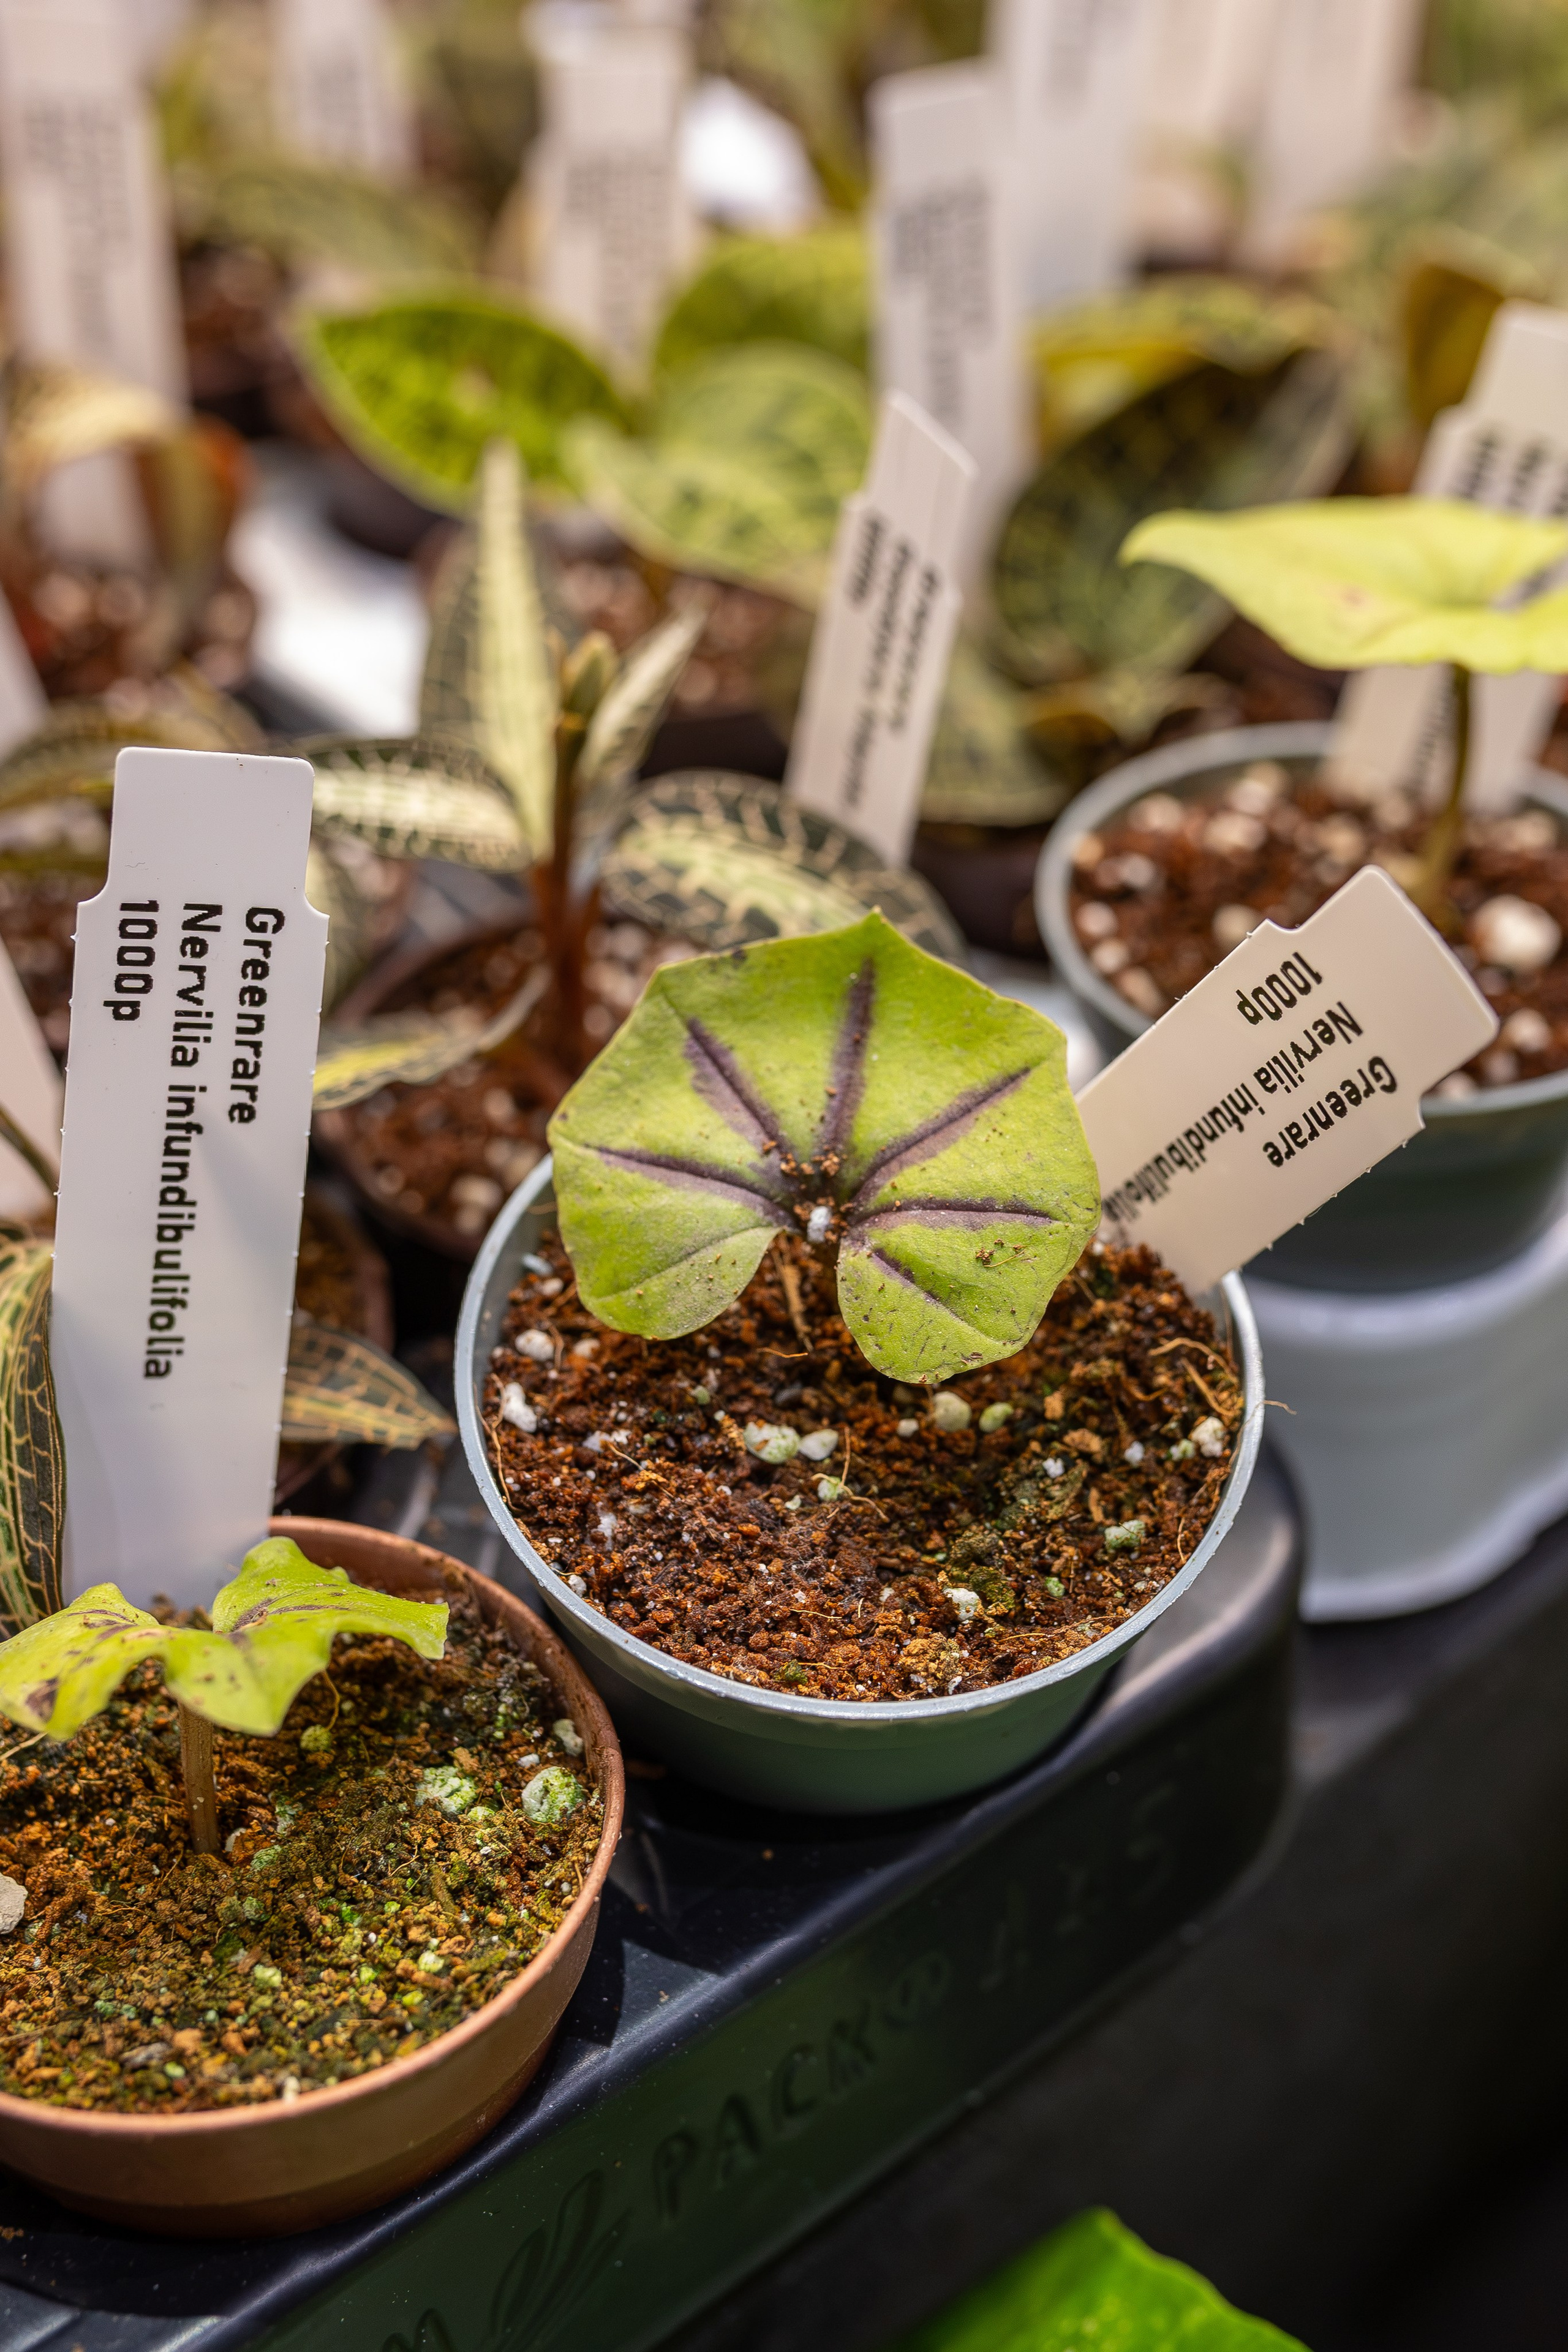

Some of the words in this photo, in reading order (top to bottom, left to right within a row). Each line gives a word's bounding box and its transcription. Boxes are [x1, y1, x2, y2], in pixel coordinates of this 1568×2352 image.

[104, 899, 159, 1022] 1000p
[170, 902, 224, 1068] Nervilia
[228, 906, 285, 1125] Greenrare
[1235, 952, 1323, 1025] 1000p
[1253, 1001, 1363, 1094] Nervilia
[1262, 1056, 1398, 1167] Greenrare
[143, 1084, 208, 1380] infundibulifolia
